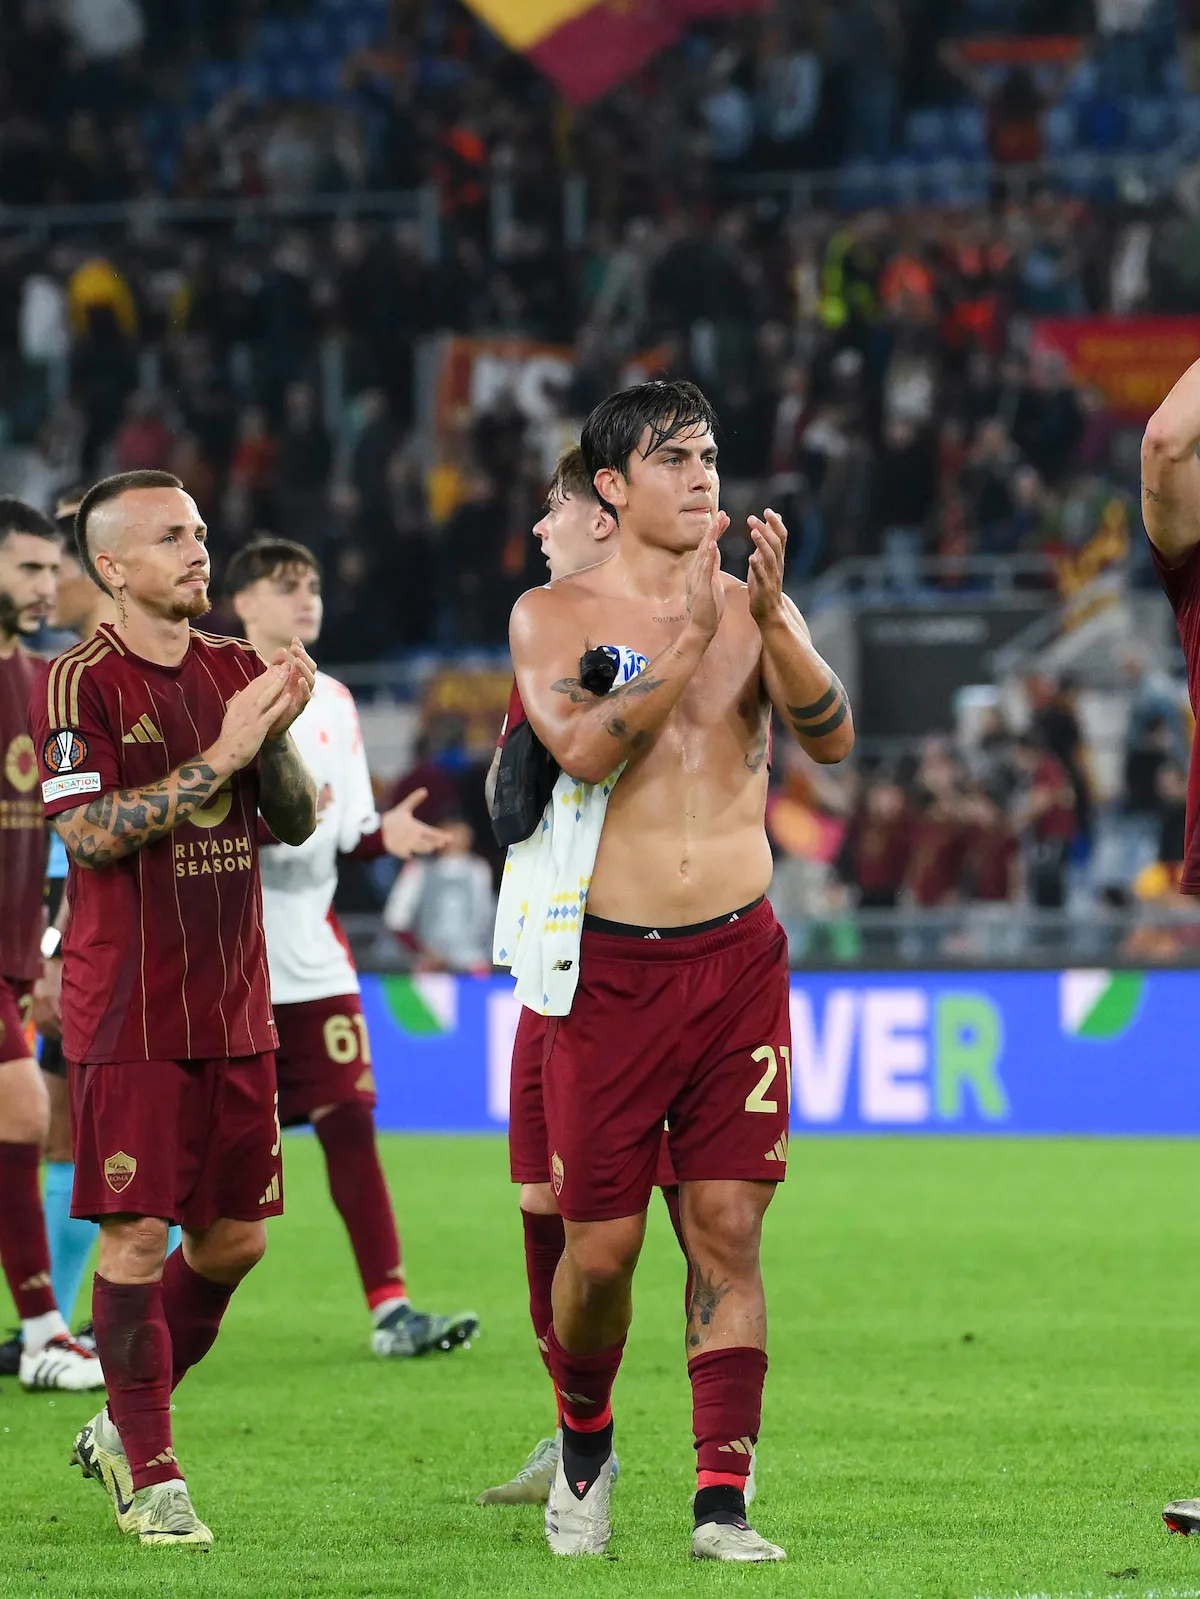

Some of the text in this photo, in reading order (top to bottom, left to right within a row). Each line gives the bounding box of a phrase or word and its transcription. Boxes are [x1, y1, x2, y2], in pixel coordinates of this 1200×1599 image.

[44, 778, 99, 794] FOUNDATION
[175, 836, 250, 859] RIYADH
[175, 855, 252, 878] SEASON
[323, 1013, 371, 1065] 61
[744, 1045, 792, 1114] 21
